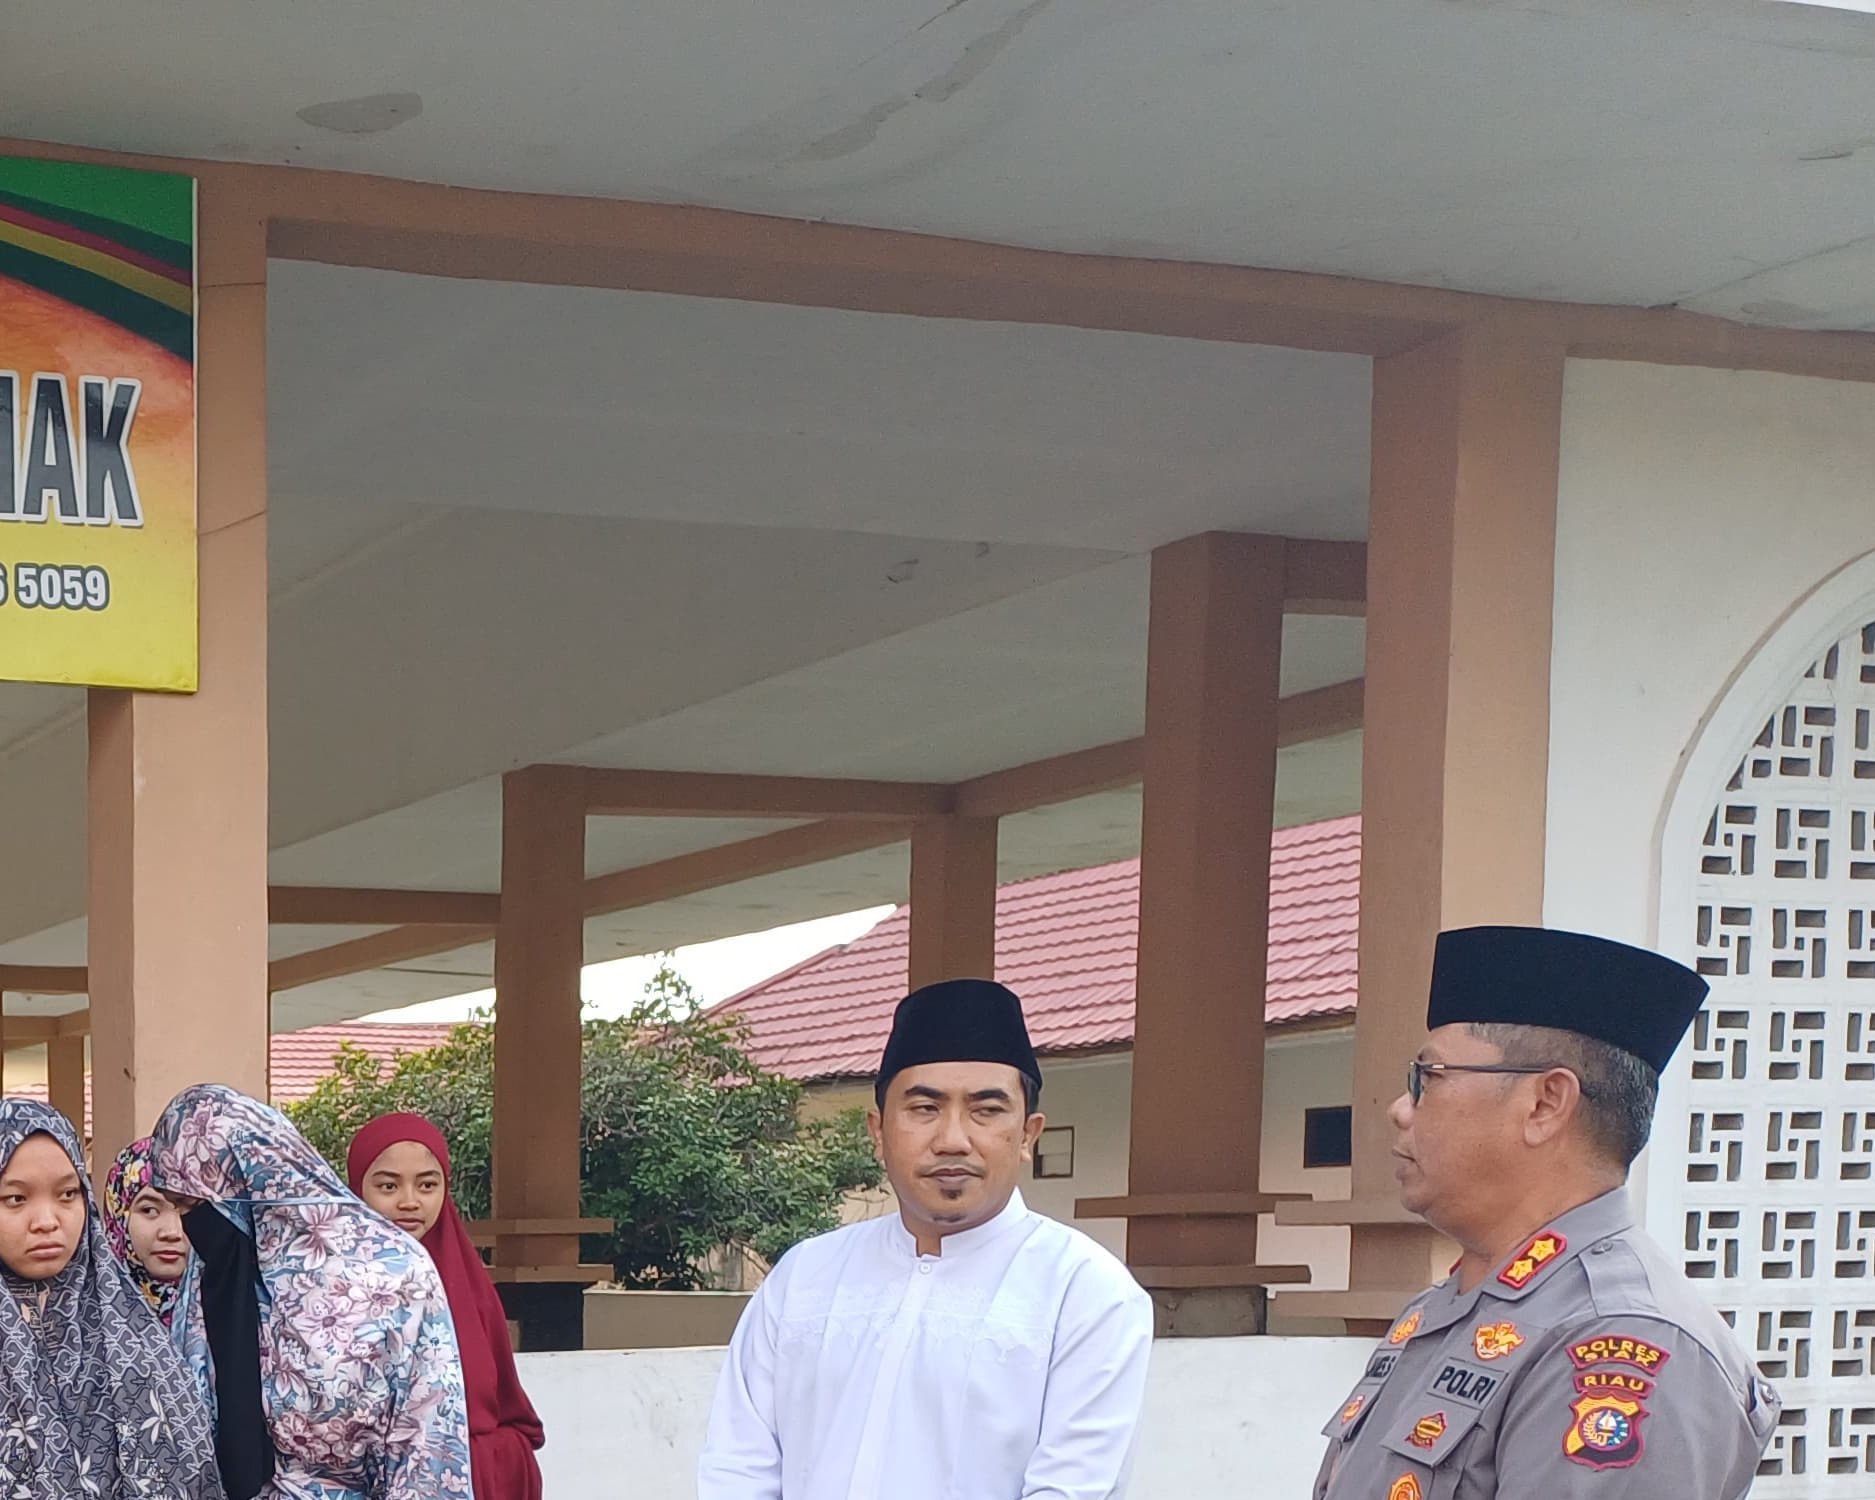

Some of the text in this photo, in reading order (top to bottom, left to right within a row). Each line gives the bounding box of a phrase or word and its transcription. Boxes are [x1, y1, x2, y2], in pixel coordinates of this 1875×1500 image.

[15, 562, 110, 611] 5059
[1575, 1338, 1660, 1361] POLRES
[1433, 1365, 1496, 1404] POLRI
[1584, 1374, 1644, 1390] RIAU
